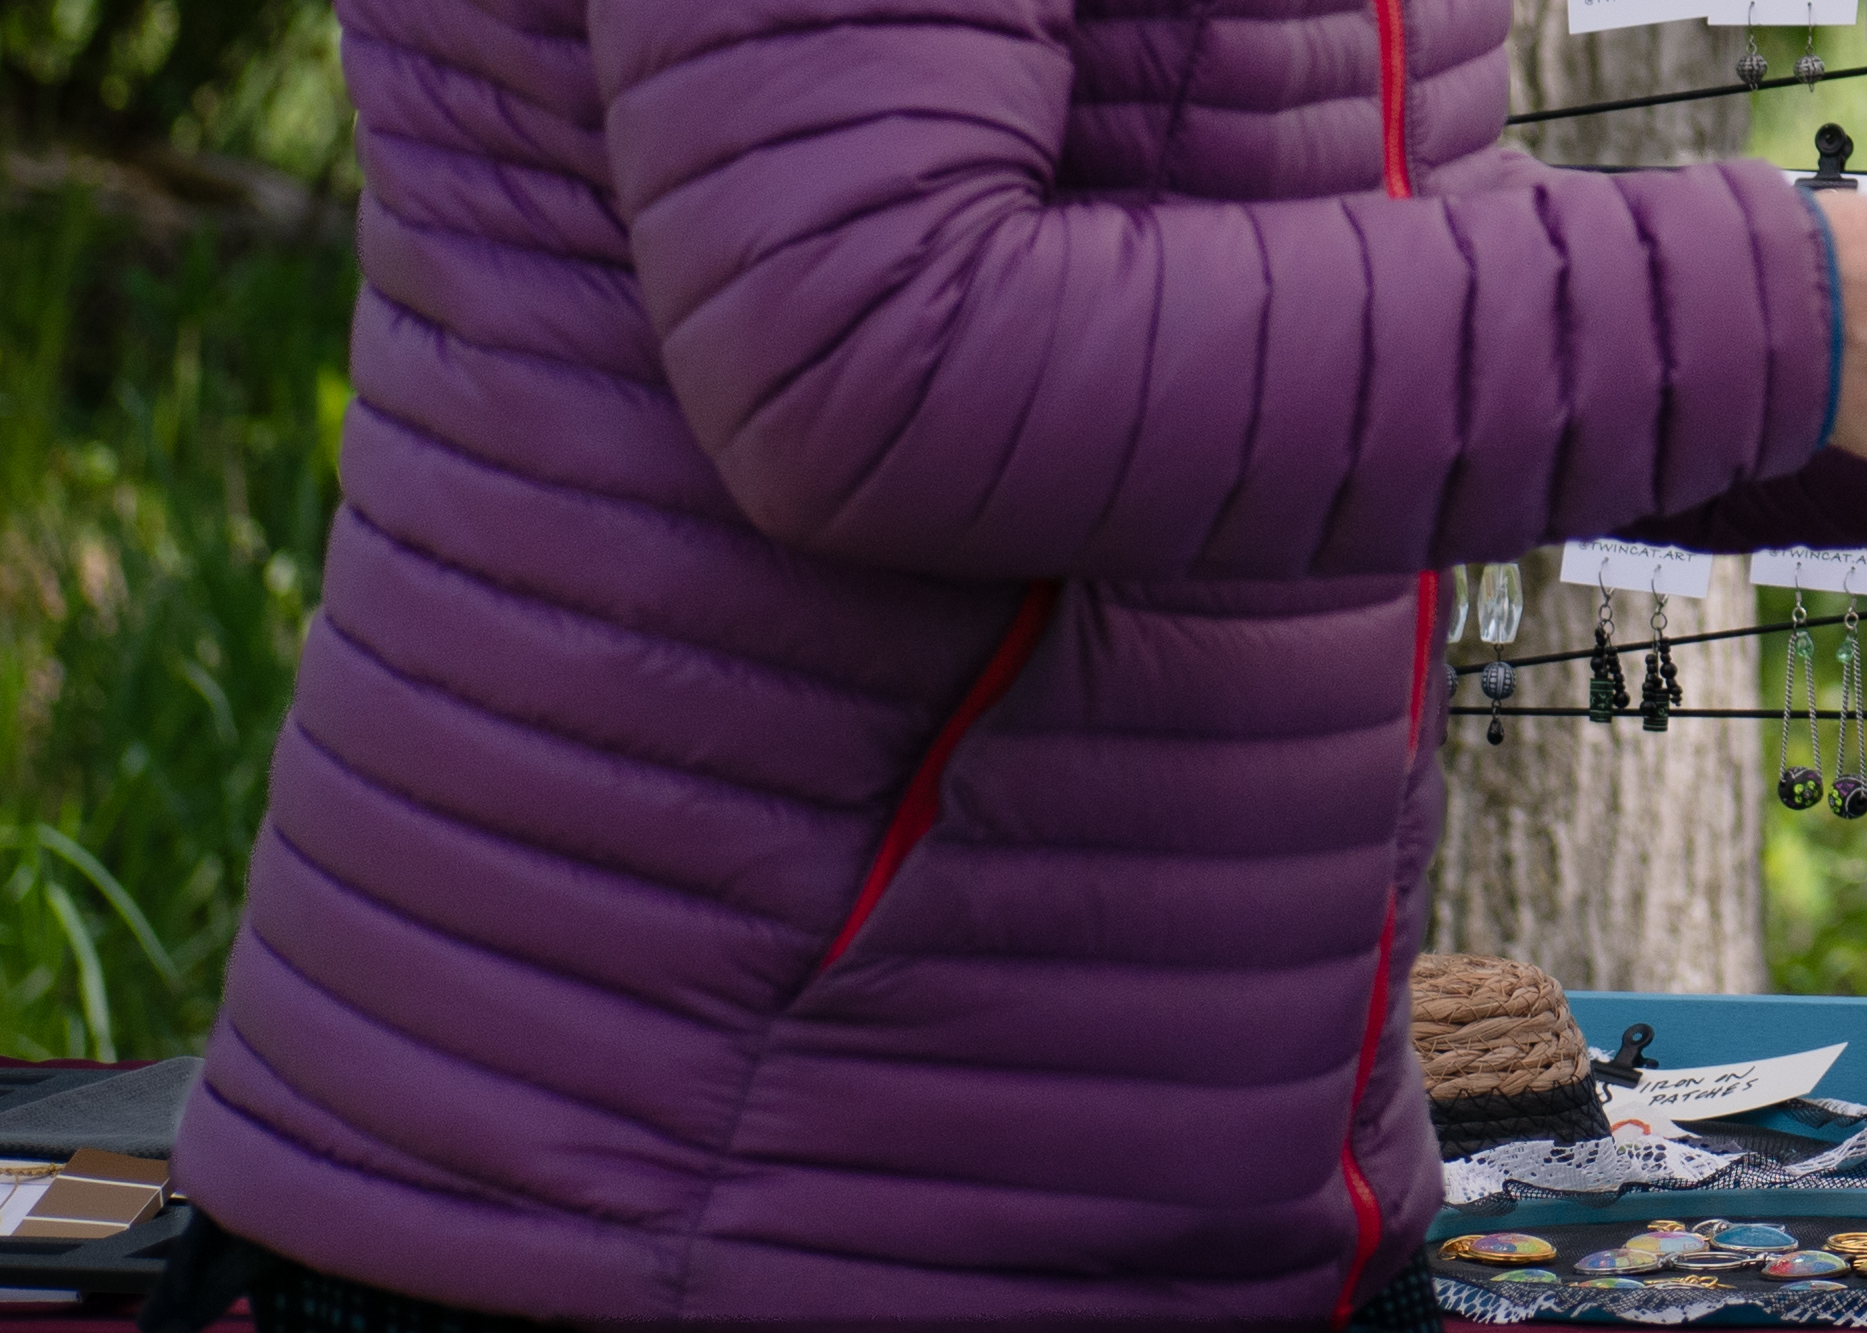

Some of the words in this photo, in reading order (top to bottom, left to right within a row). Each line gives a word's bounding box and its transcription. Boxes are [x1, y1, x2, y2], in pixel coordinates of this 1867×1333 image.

[1640, 1077, 1705, 1094] IRON
[1714, 1066, 1756, 1083] ON
[1648, 1077, 1759, 1107] PATCHES
